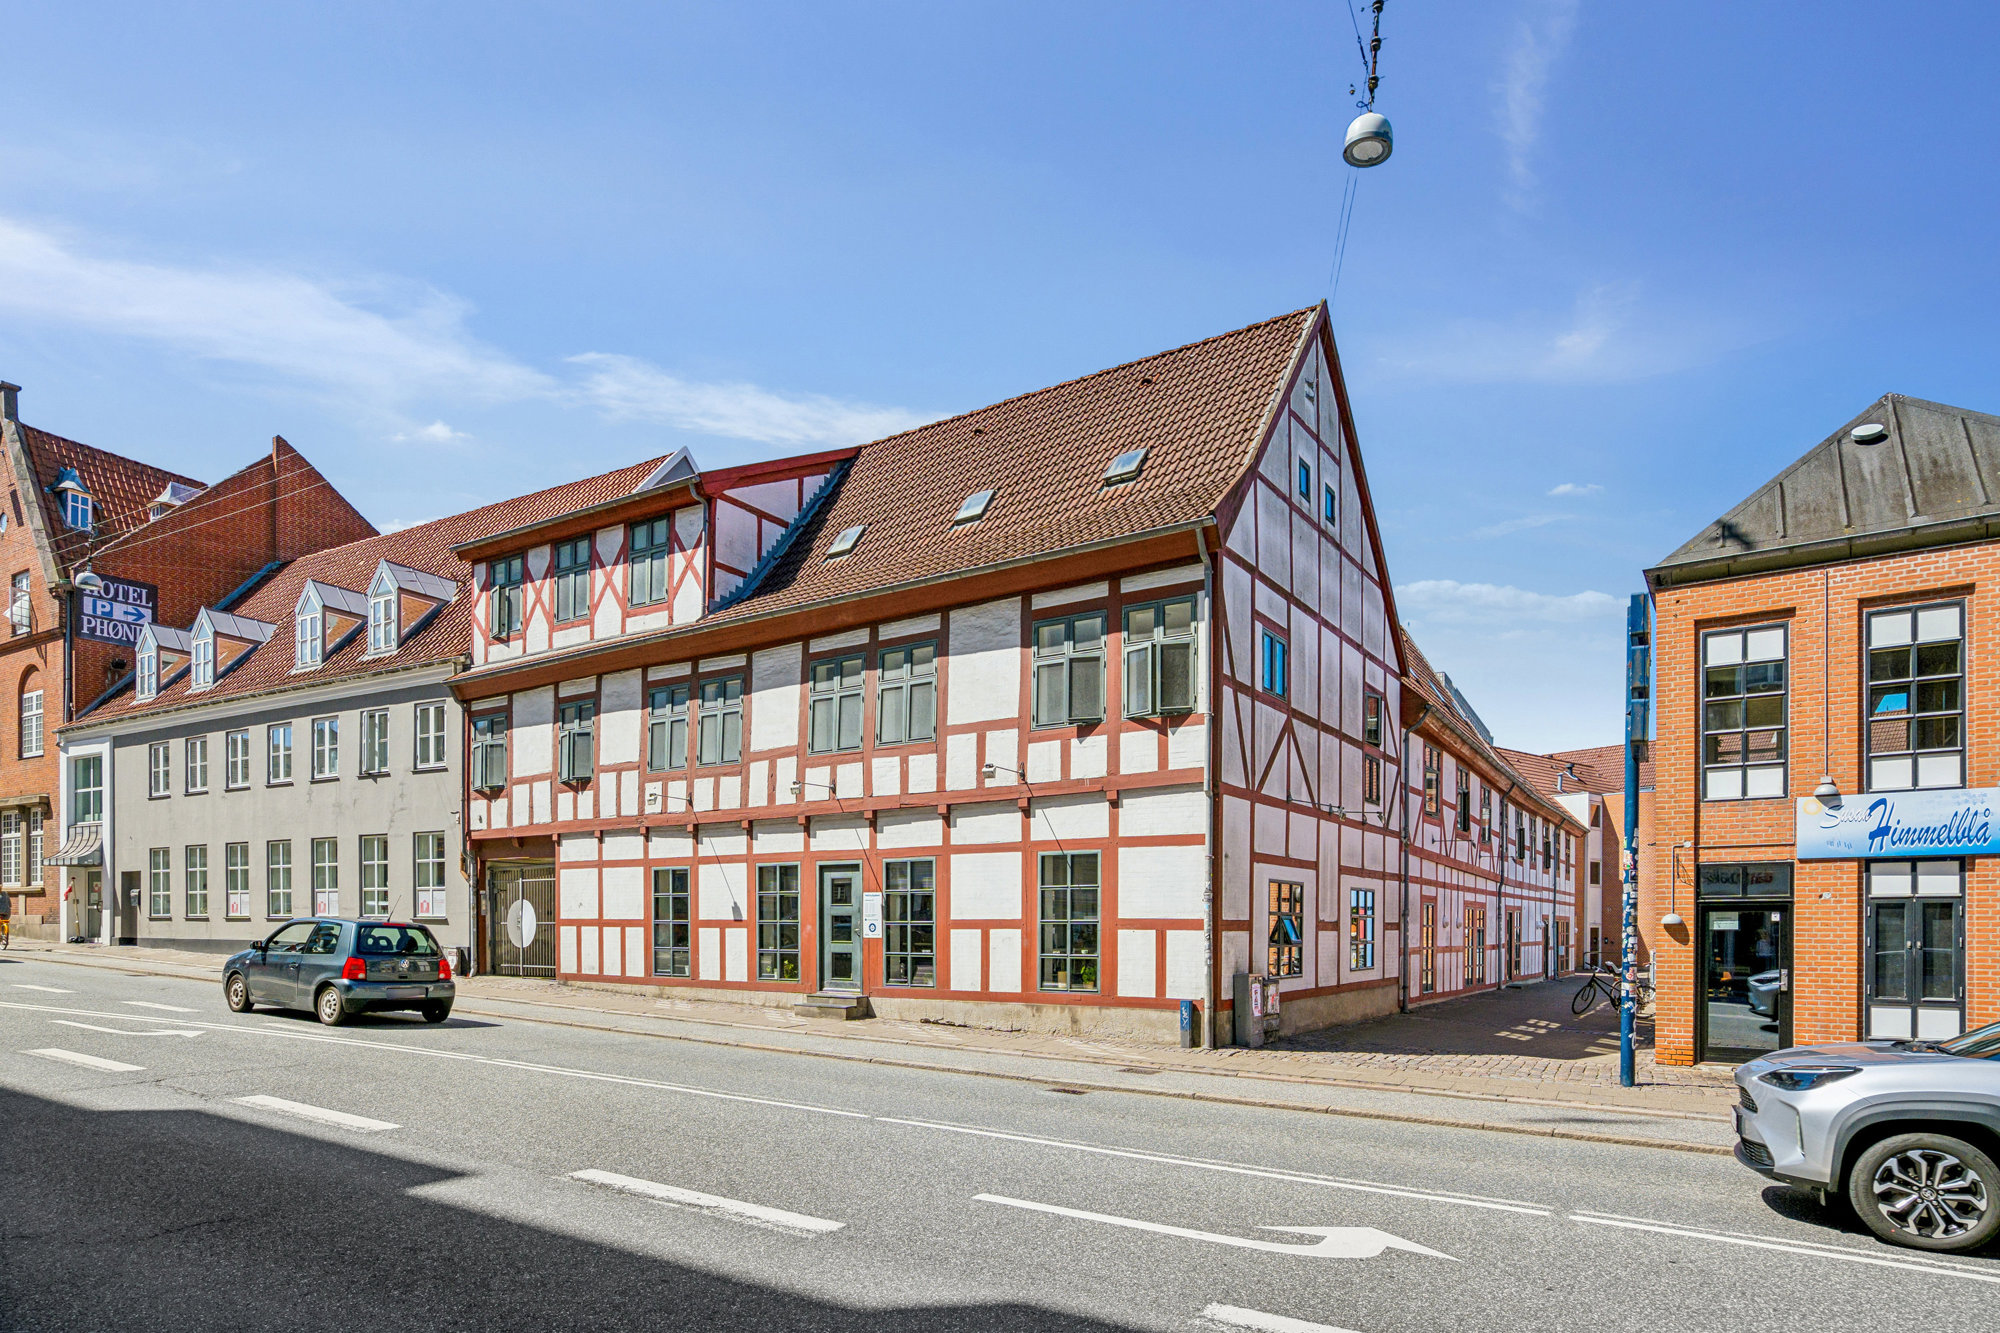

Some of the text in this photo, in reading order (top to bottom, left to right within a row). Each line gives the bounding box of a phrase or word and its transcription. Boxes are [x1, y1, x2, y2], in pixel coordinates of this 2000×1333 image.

[96, 600, 111, 617] P
[81, 615, 143, 643] PHØNI
[1868, 798, 1992, 853] Himmelblå
